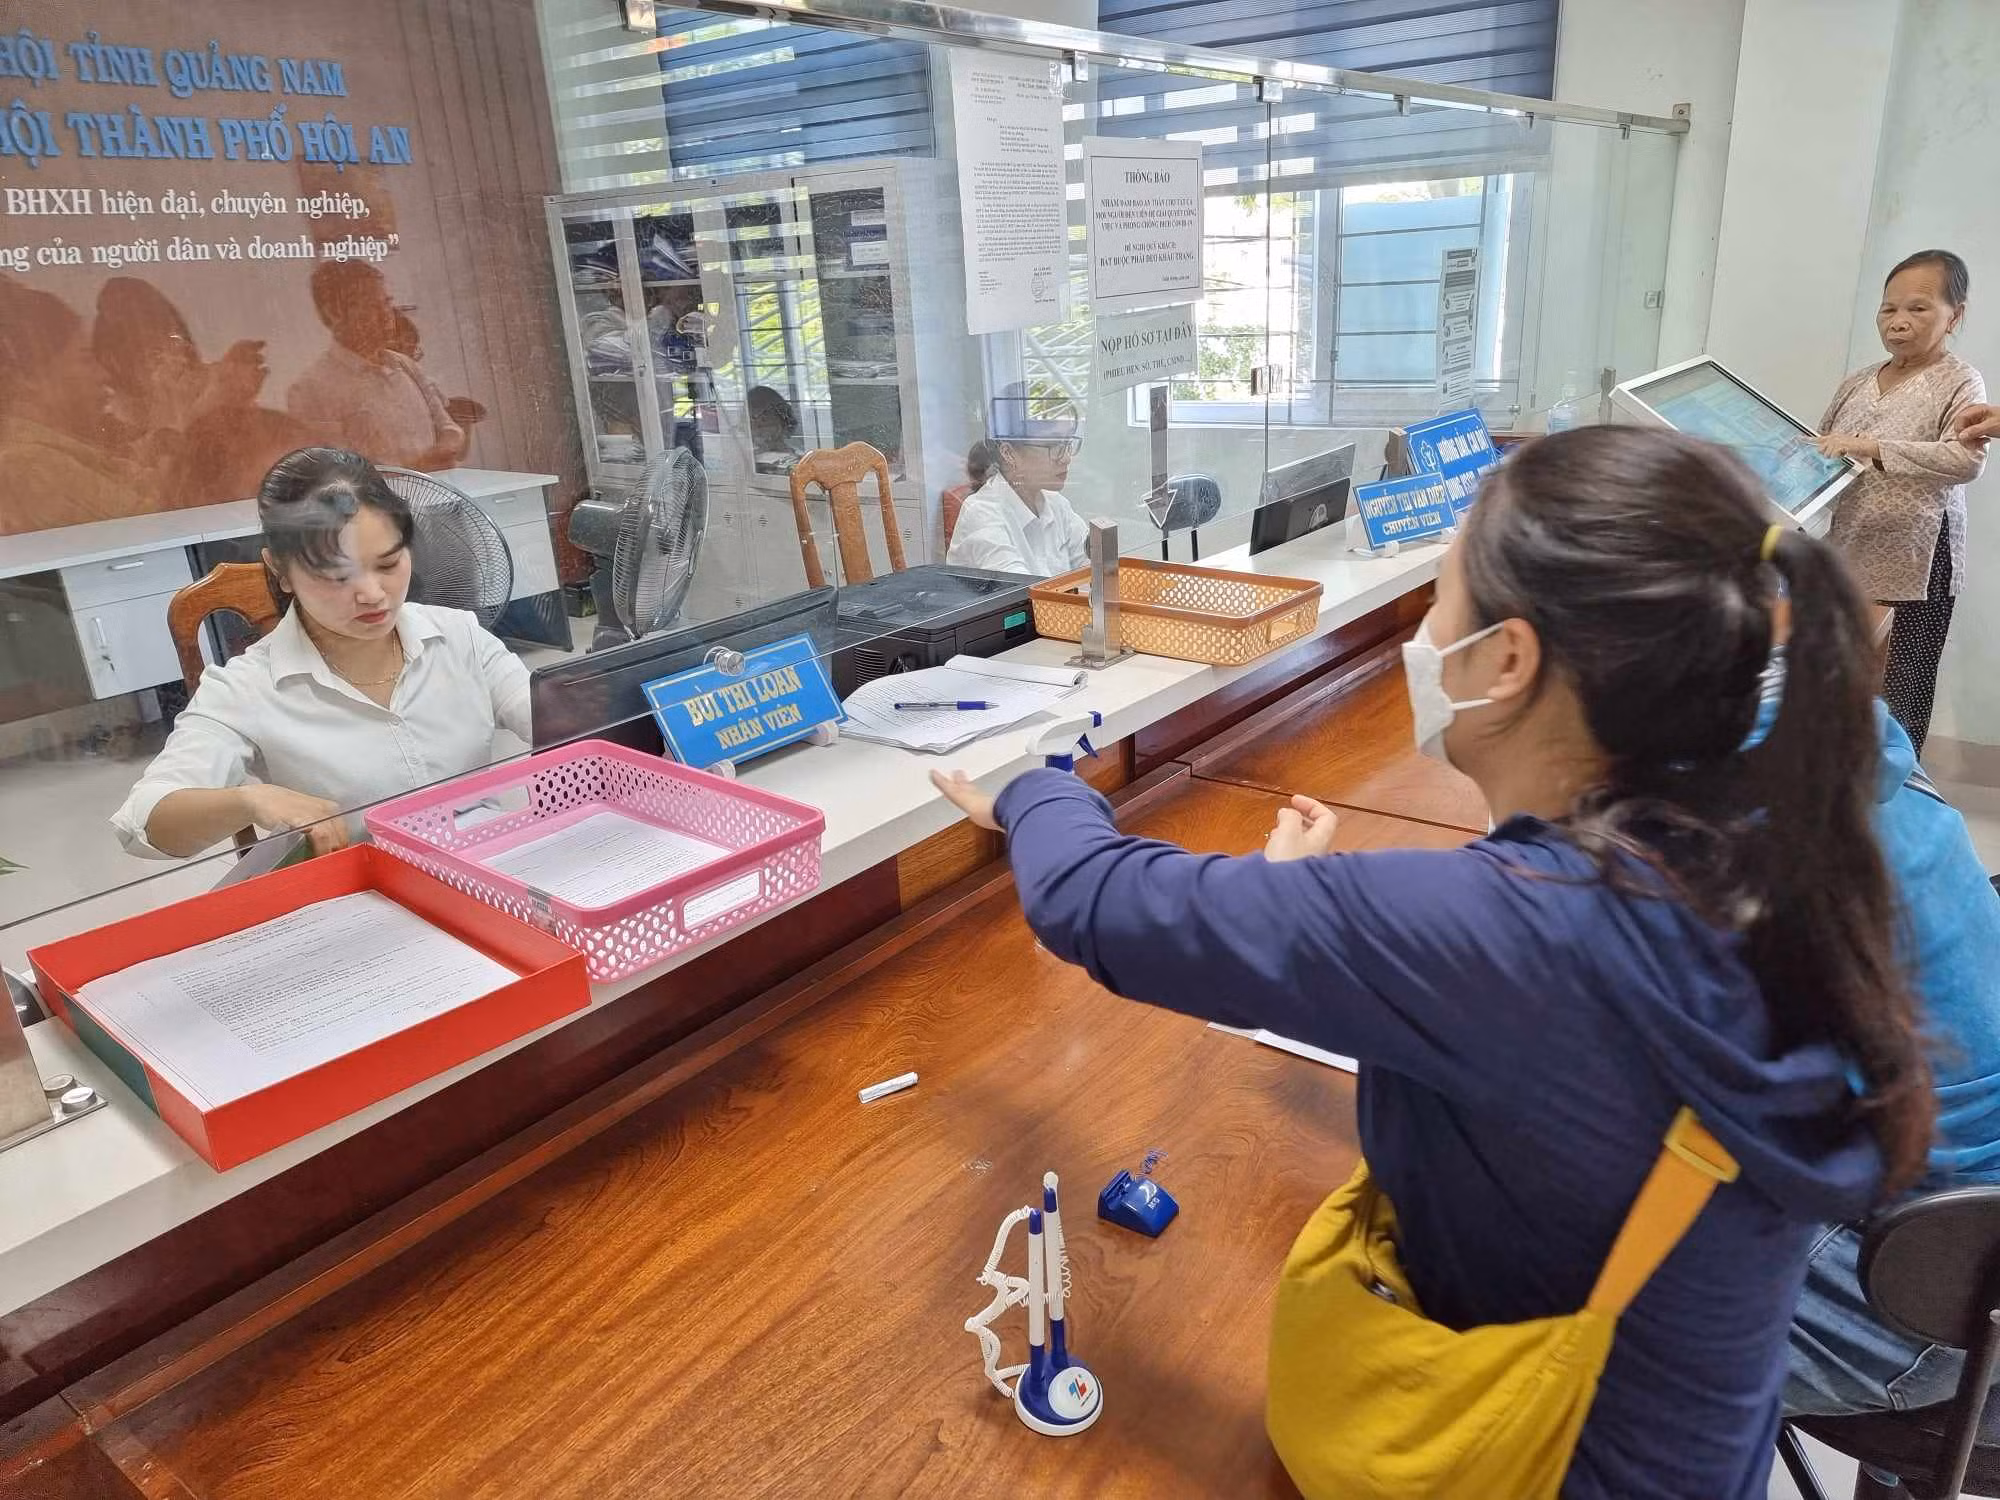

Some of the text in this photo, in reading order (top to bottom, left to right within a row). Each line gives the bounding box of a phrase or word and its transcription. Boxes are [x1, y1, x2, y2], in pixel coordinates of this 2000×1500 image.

[66, 31, 160, 86] TỈNH
[163, 39, 273, 97] QUẢNG
[278, 57, 347, 97] NAM
[66, 104, 214, 160] THÀNH
[219, 103, 293, 160] PHỐ
[297, 111, 359, 173] HỘI
[369, 126, 413, 164] AN
[4, 188, 370, 221] BHXH hiện đại, chuyên nghiệp,
[37, 237, 83, 266] của
[91, 238, 160, 268] người
[167, 236, 211, 262] dân
[216, 237, 242, 260] và
[248, 235, 315, 260] doanh
[751, 664, 804, 703] LOAN
[714, 703, 804, 750] NHÂN VIÊN
